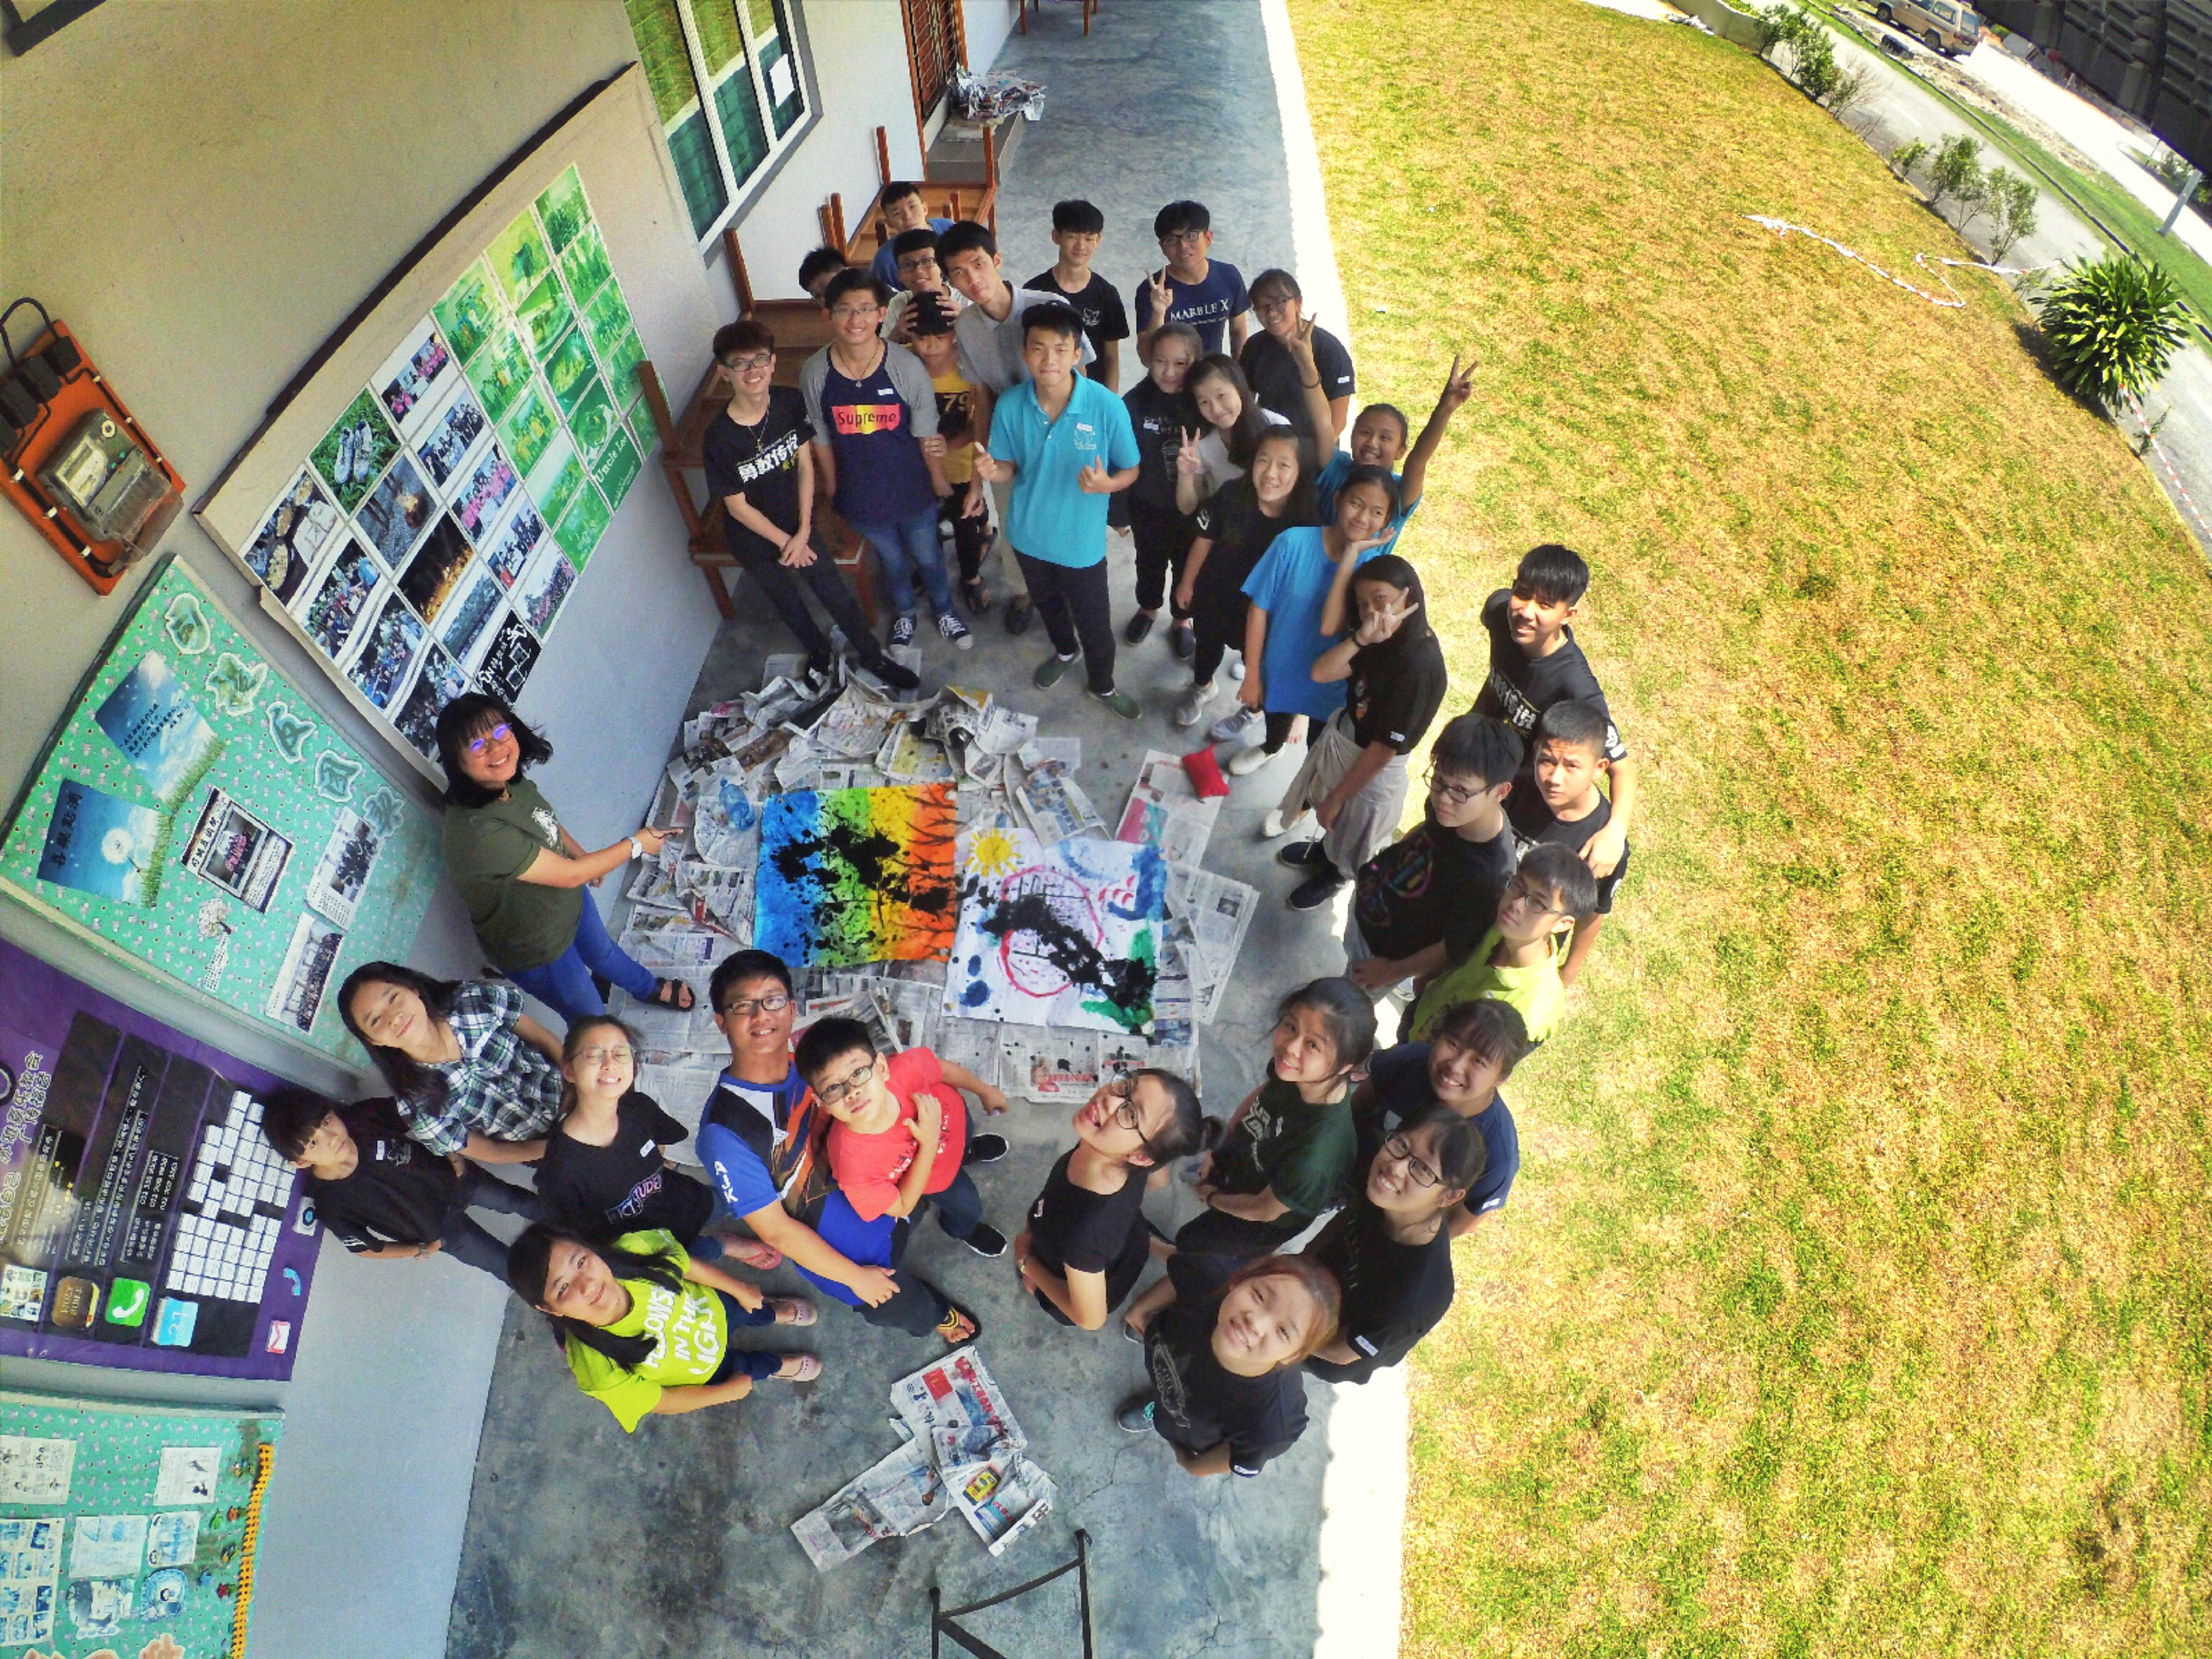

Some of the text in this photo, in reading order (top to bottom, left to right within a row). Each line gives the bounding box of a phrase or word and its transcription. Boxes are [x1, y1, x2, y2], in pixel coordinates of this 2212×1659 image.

[1171, 299, 1229, 321] MARBLE X
[837, 411, 896, 427] Supreme
[596, 450, 618, 483] Uncle
[673, 1335, 691, 1362] IN
